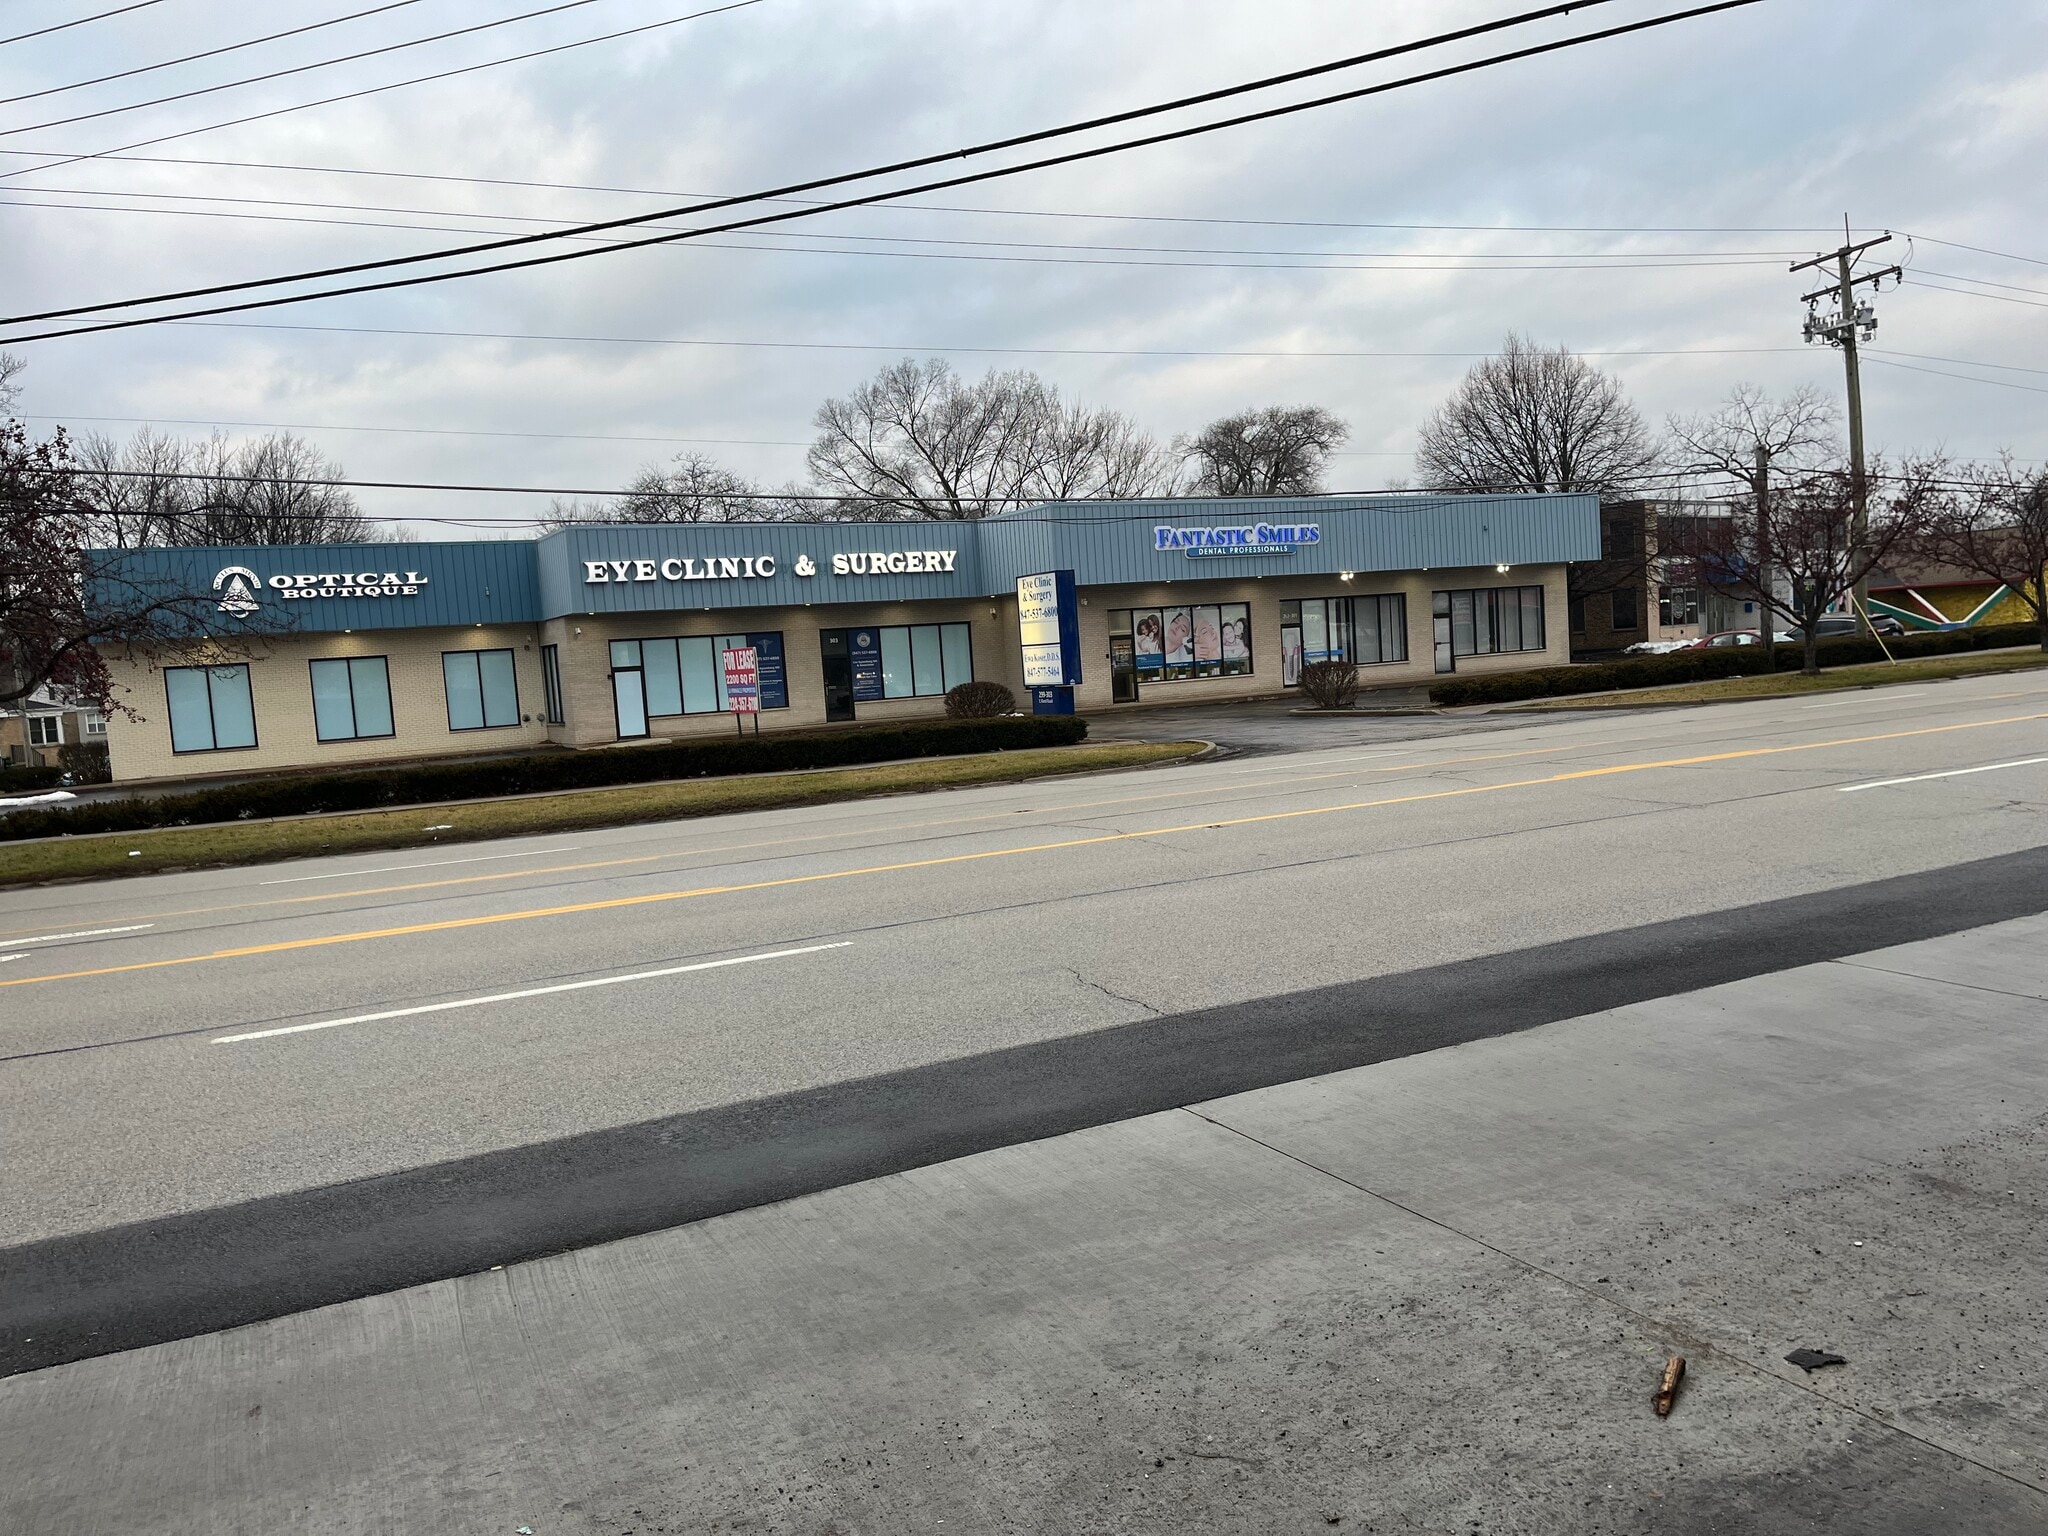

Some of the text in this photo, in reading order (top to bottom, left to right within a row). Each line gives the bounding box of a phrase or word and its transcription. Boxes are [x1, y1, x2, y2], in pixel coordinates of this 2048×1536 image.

[1156, 525, 1320, 548] FANTASTIC SMILES
[1198, 545, 1288, 555] DENTAL PROFESSIONALS
[584, 550, 958, 584] EYE CLINIC & SURGERY
[268, 571, 429, 589] OPTICAL
[1022, 576, 1052, 591] Eye Clinic
[281, 585, 419, 599] BOUTIQUE
[1022, 591, 1052, 603] & Surgery
[722, 649, 755, 670] FOR LEASE
[726, 674, 740, 684] 2200
[740, 674, 748, 685] SQ
[748, 673, 756, 684] FT
